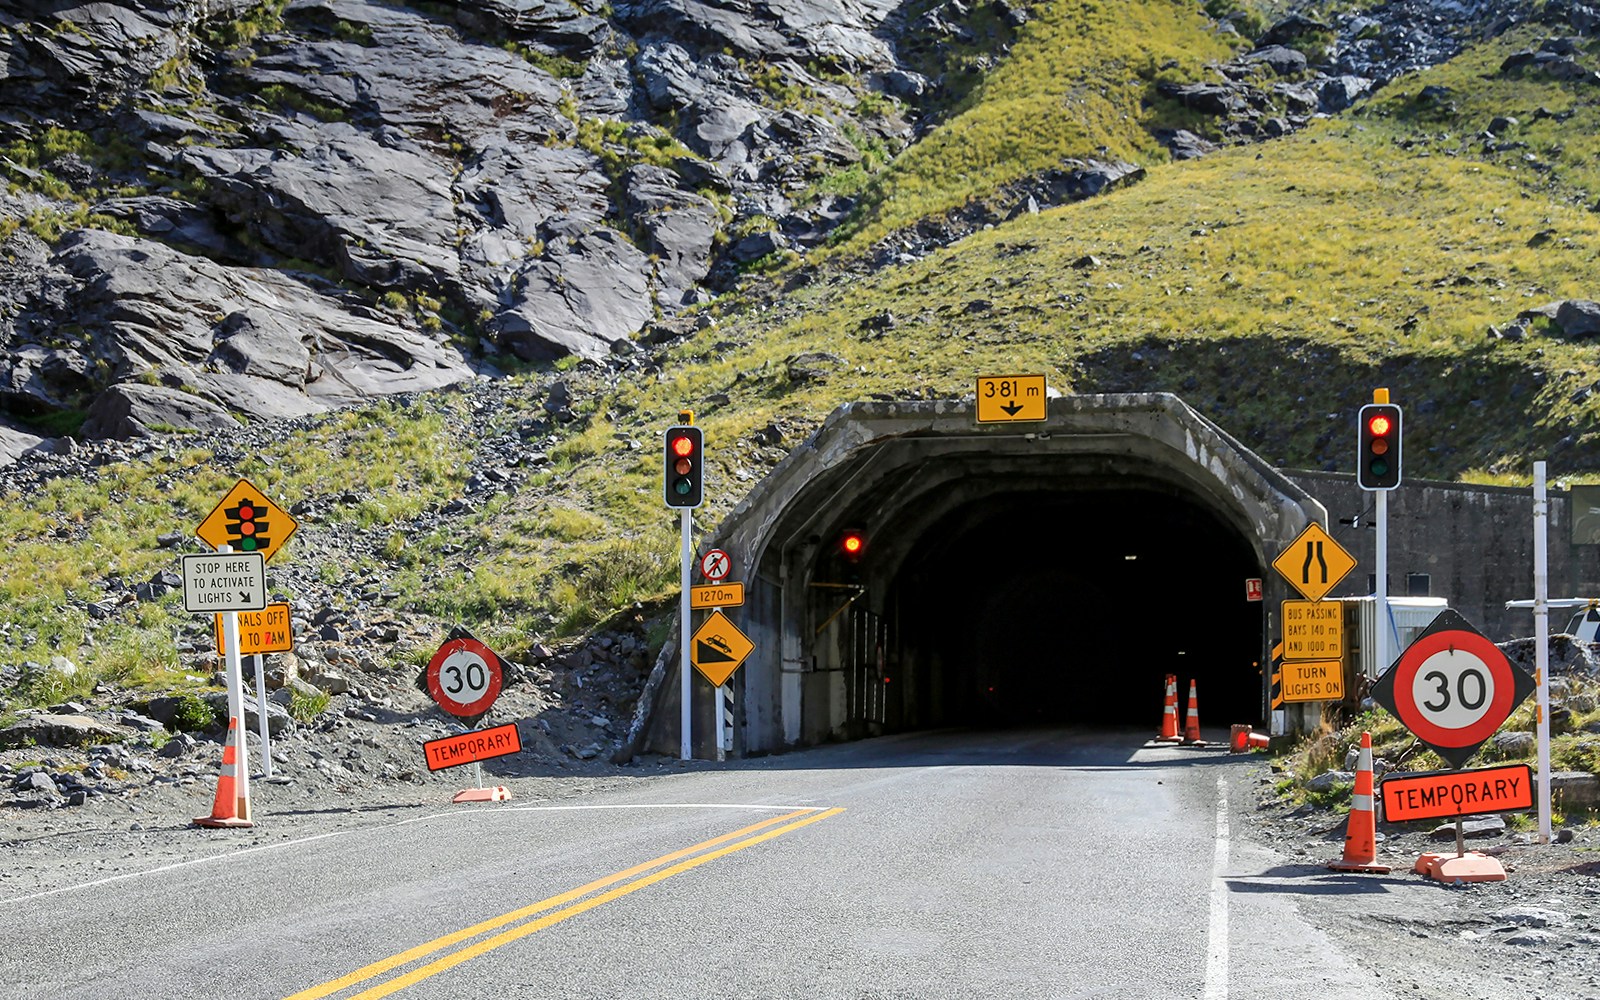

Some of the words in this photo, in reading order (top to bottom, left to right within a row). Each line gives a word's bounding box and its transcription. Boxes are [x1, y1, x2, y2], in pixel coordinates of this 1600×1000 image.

[1027, 386, 1038, 396] m
[196, 562, 220, 574] STOP
[226, 562, 250, 573] HERE
[194, 578, 205, 589] TO
[210, 576, 254, 588] ACTIVATE
[198, 592, 232, 604] LIGHTS
[700, 590, 733, 602] 1270m
[266, 611, 284, 626] OFF
[1288, 608, 1302, 620] BUS
[1306, 608, 1337, 620] PASSING
[1288, 624, 1306, 636] BAYS
[1311, 624, 1325, 636] 140
[1328, 627, 1338, 635] m
[248, 632, 260, 646] TO
[264, 631, 285, 645] 7AM
[1288, 640, 1302, 652] AND
[1307, 640, 1324, 652] 1000
[445, 663, 485, 694] 30
[1296, 667, 1326, 679] TURN
[1285, 684, 1320, 696] LIGHTS
[1326, 682, 1340, 694] ON
[1423, 668, 1486, 712] 30
[432, 732, 512, 762] TEMPORARY
[1394, 777, 1520, 810] TEMPORARY
